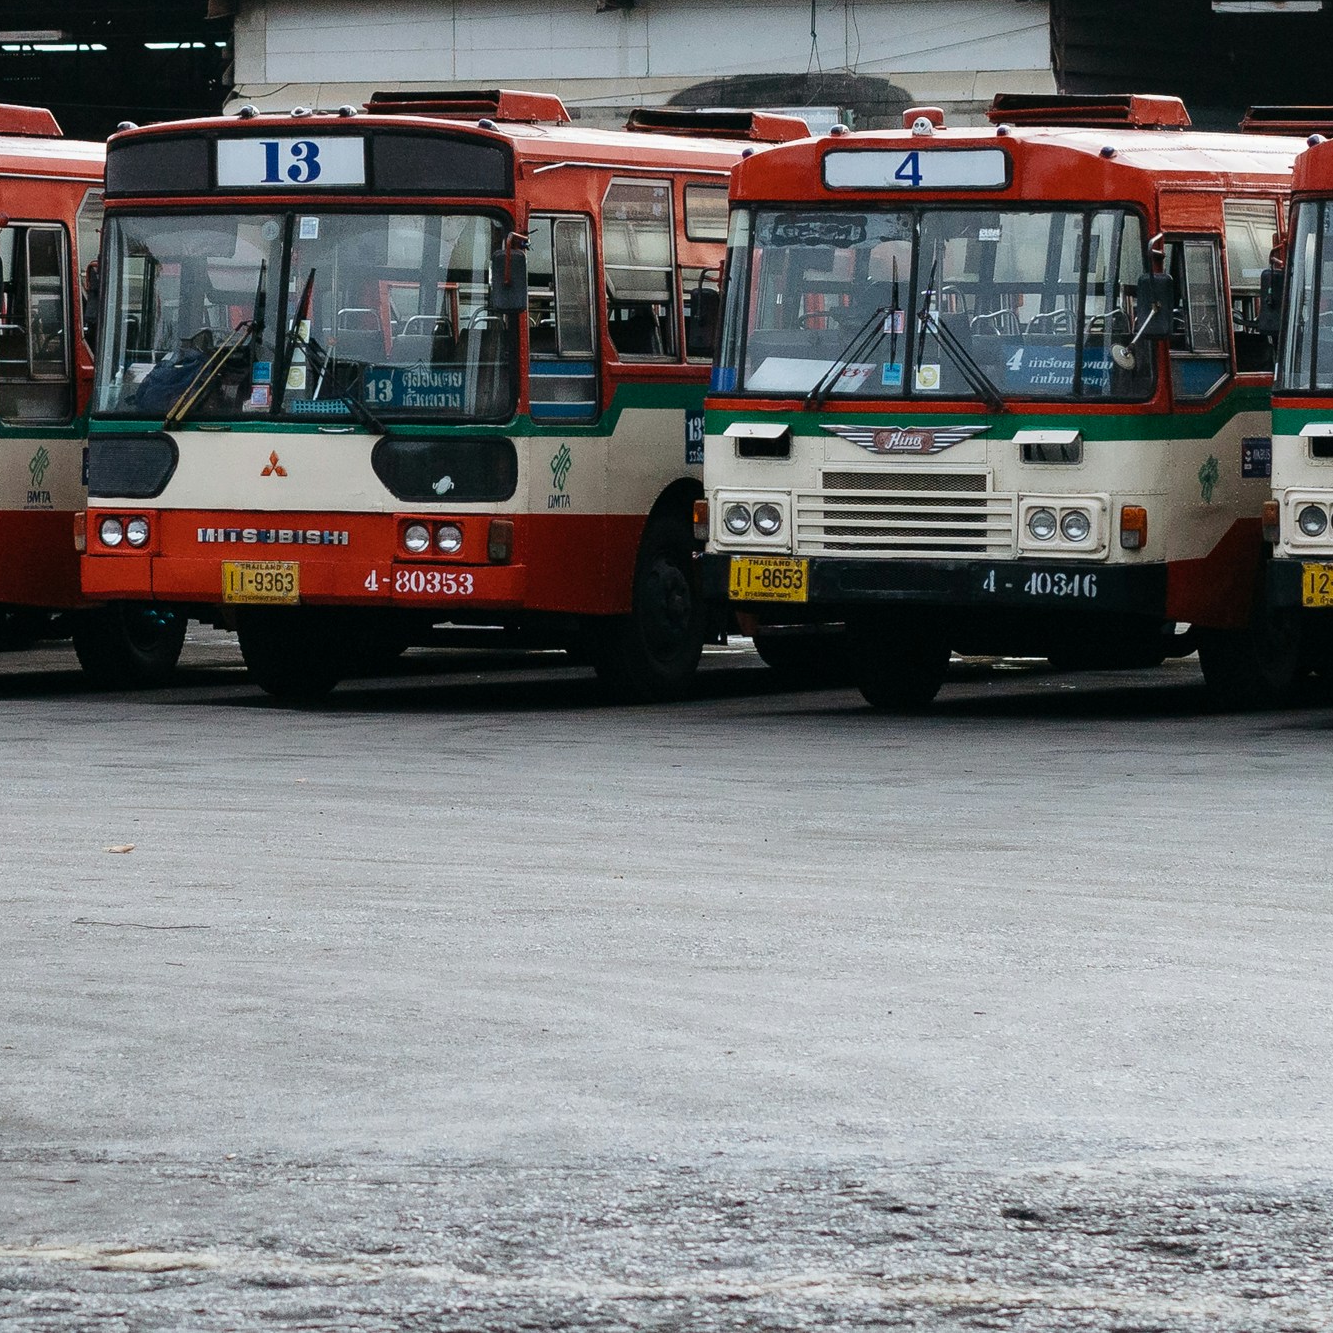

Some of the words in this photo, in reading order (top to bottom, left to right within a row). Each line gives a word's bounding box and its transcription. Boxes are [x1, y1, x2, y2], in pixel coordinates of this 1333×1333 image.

[259, 141, 322, 183] 13
[895, 151, 923, 186] 4
[1006, 348, 1024, 371] 4
[366, 379, 394, 403] 13
[687, 417, 703, 442] 13
[884, 432, 923, 449] Hino
[27, 490, 52, 504] BMTA
[197, 527, 349, 545] MITSUBISHI
[240, 563, 281, 572] THAILAND
[749, 559, 791, 567] THAILAND
[230, 570, 295, 593] 11-9363
[364, 569, 474, 595] 4-80353
[736, 567, 803, 589] 11-8653
